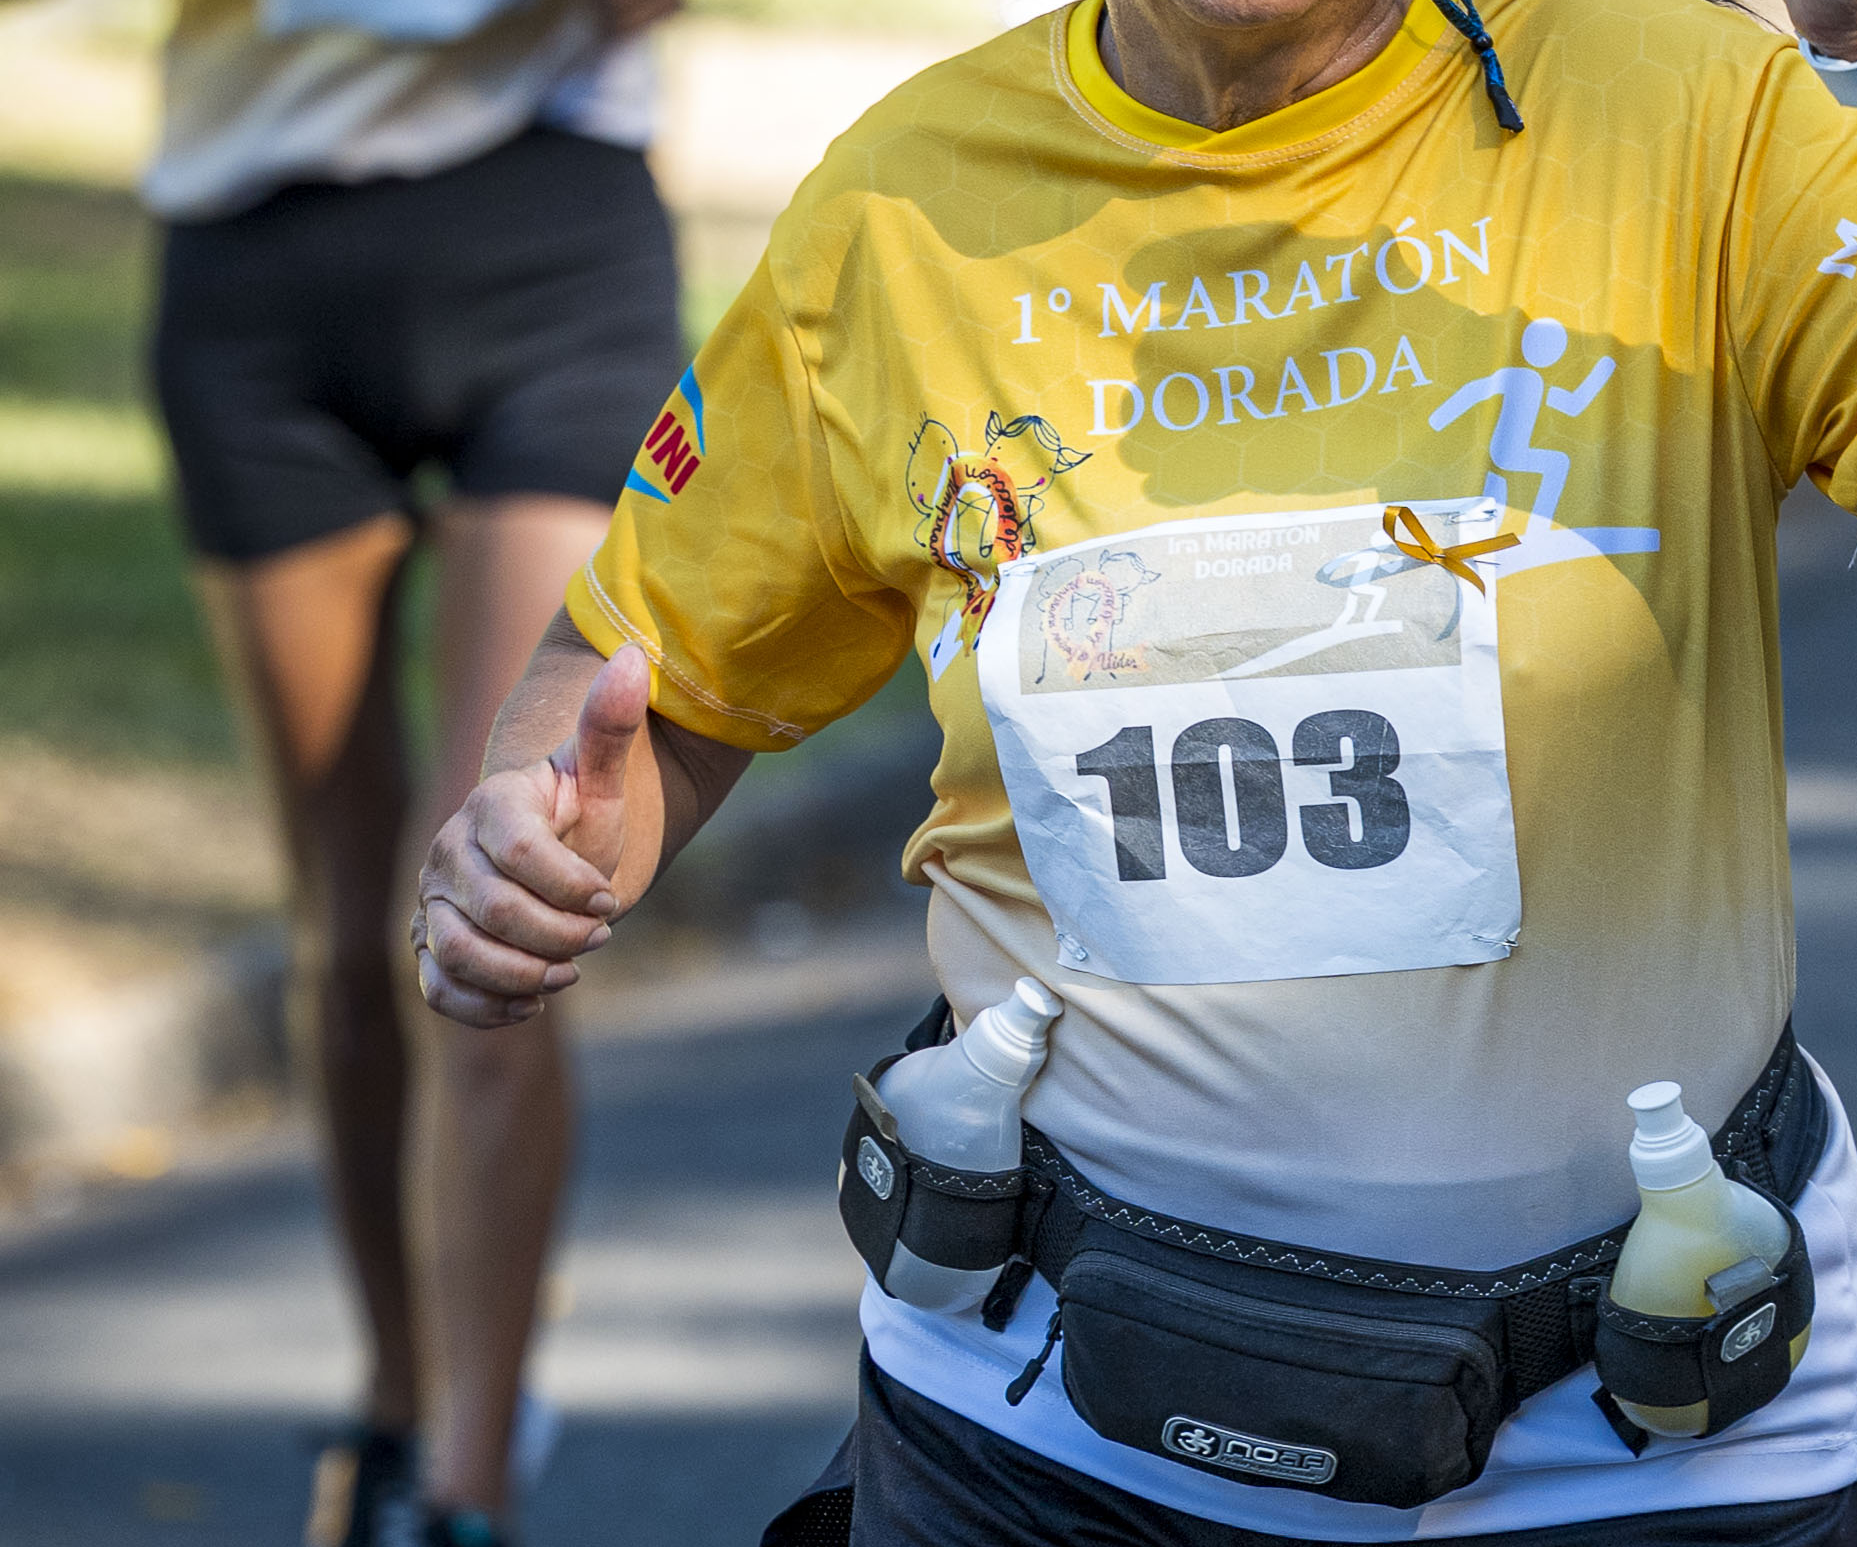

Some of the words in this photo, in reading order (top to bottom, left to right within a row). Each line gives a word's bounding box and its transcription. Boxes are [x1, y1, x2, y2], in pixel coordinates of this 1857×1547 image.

[1097, 216, 1493, 338] MARATÓN
[1086, 335, 1433, 436] DORADA
[1195, 553, 1294, 580] DORADA
[1076, 709, 1411, 882] 103
